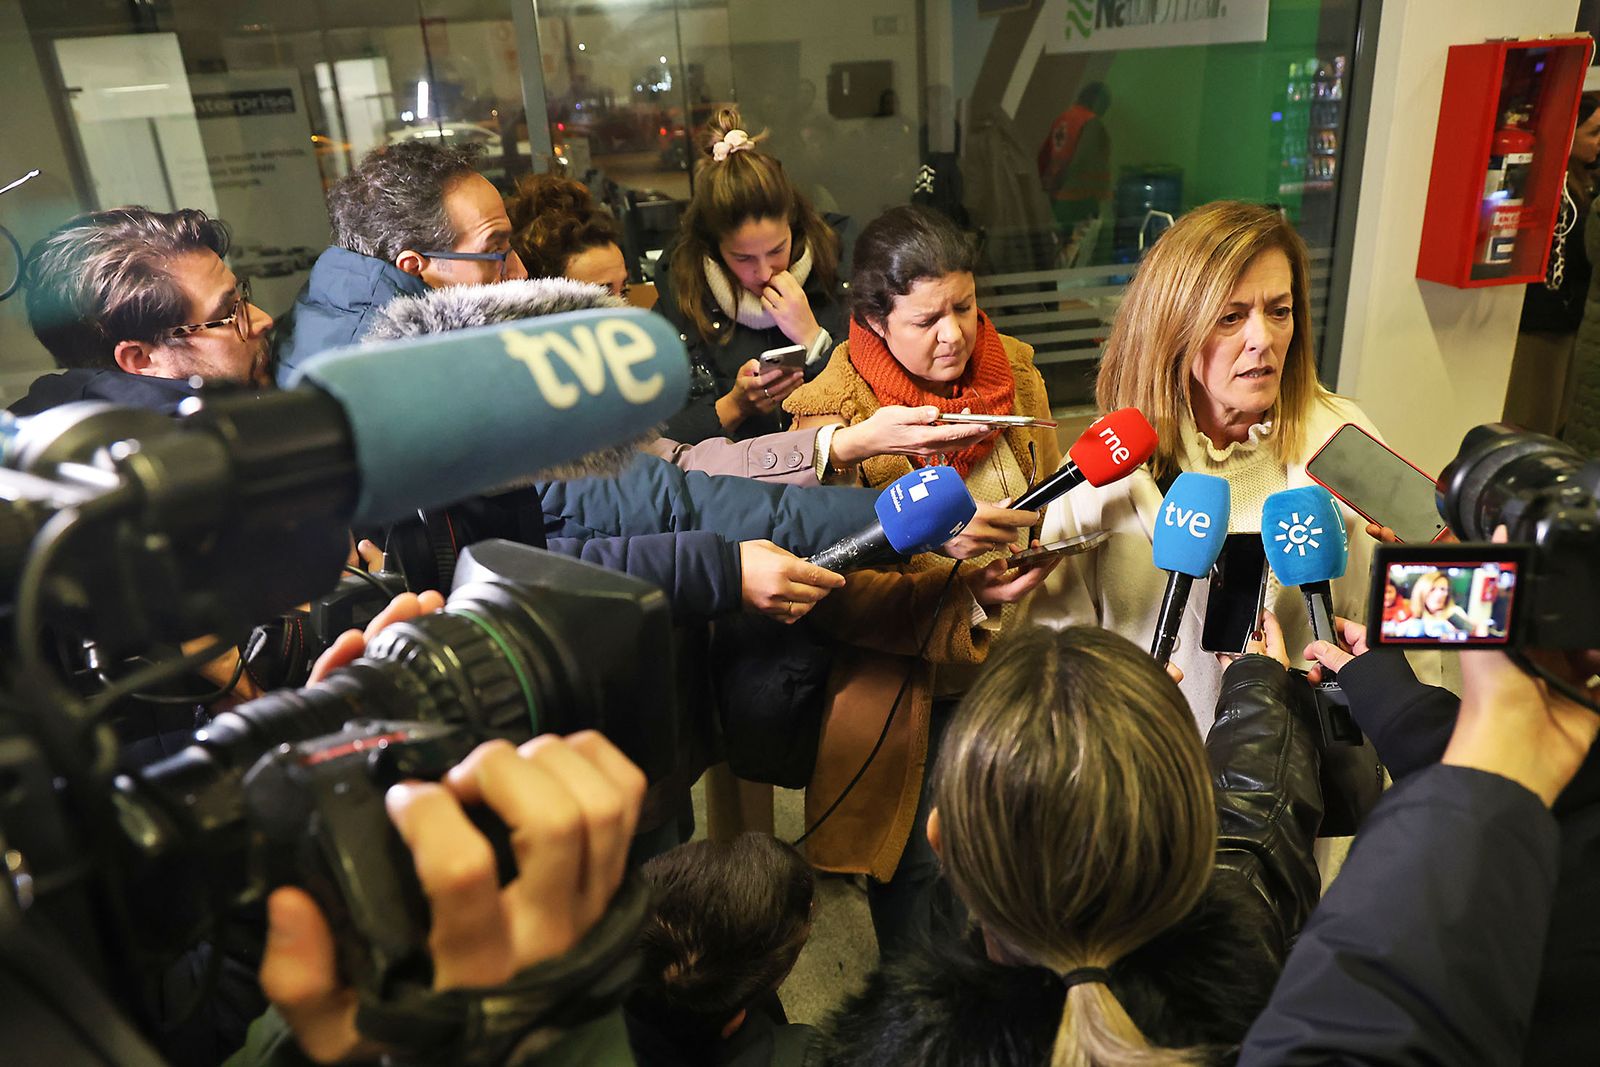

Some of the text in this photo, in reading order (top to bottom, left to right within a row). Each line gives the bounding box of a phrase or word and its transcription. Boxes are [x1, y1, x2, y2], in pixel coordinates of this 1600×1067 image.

[195, 94, 292, 114] nterprise
[499, 317, 666, 410] tve
[1099, 427, 1131, 465] rne
[1164, 501, 1212, 539] tve
